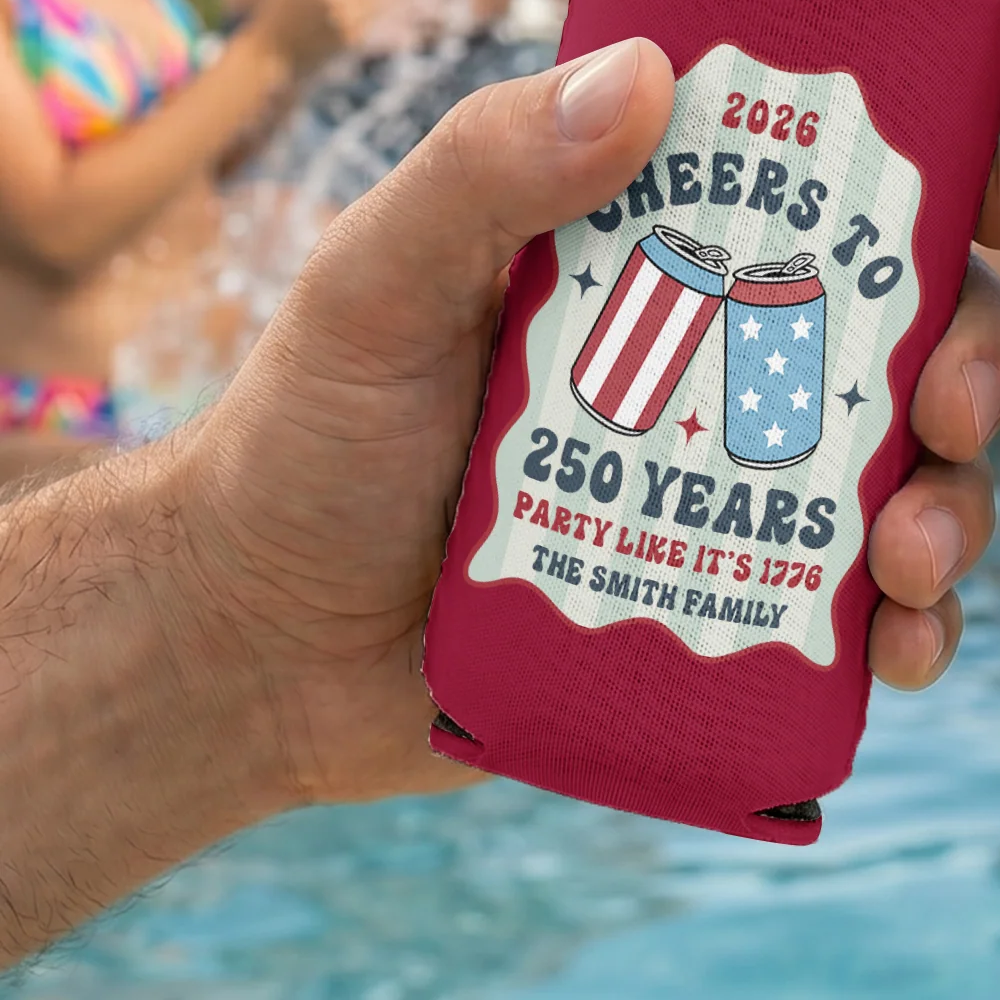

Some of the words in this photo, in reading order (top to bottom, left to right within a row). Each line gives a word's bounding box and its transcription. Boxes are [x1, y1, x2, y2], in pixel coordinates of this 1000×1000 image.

[722, 92, 820, 147] 2026
[832, 214, 904, 300] TO
[523, 427, 624, 504] 250
[643, 460, 838, 550] YEARS
[512, 490, 614, 548] PARTY
[615, 522, 688, 568] LIKE
[697, 544, 754, 582] IT'S
[759, 557, 824, 591] 1776
[531, 544, 582, 586] THE
[588, 565, 679, 609] SMITH
[684, 588, 789, 630] FAMILY
